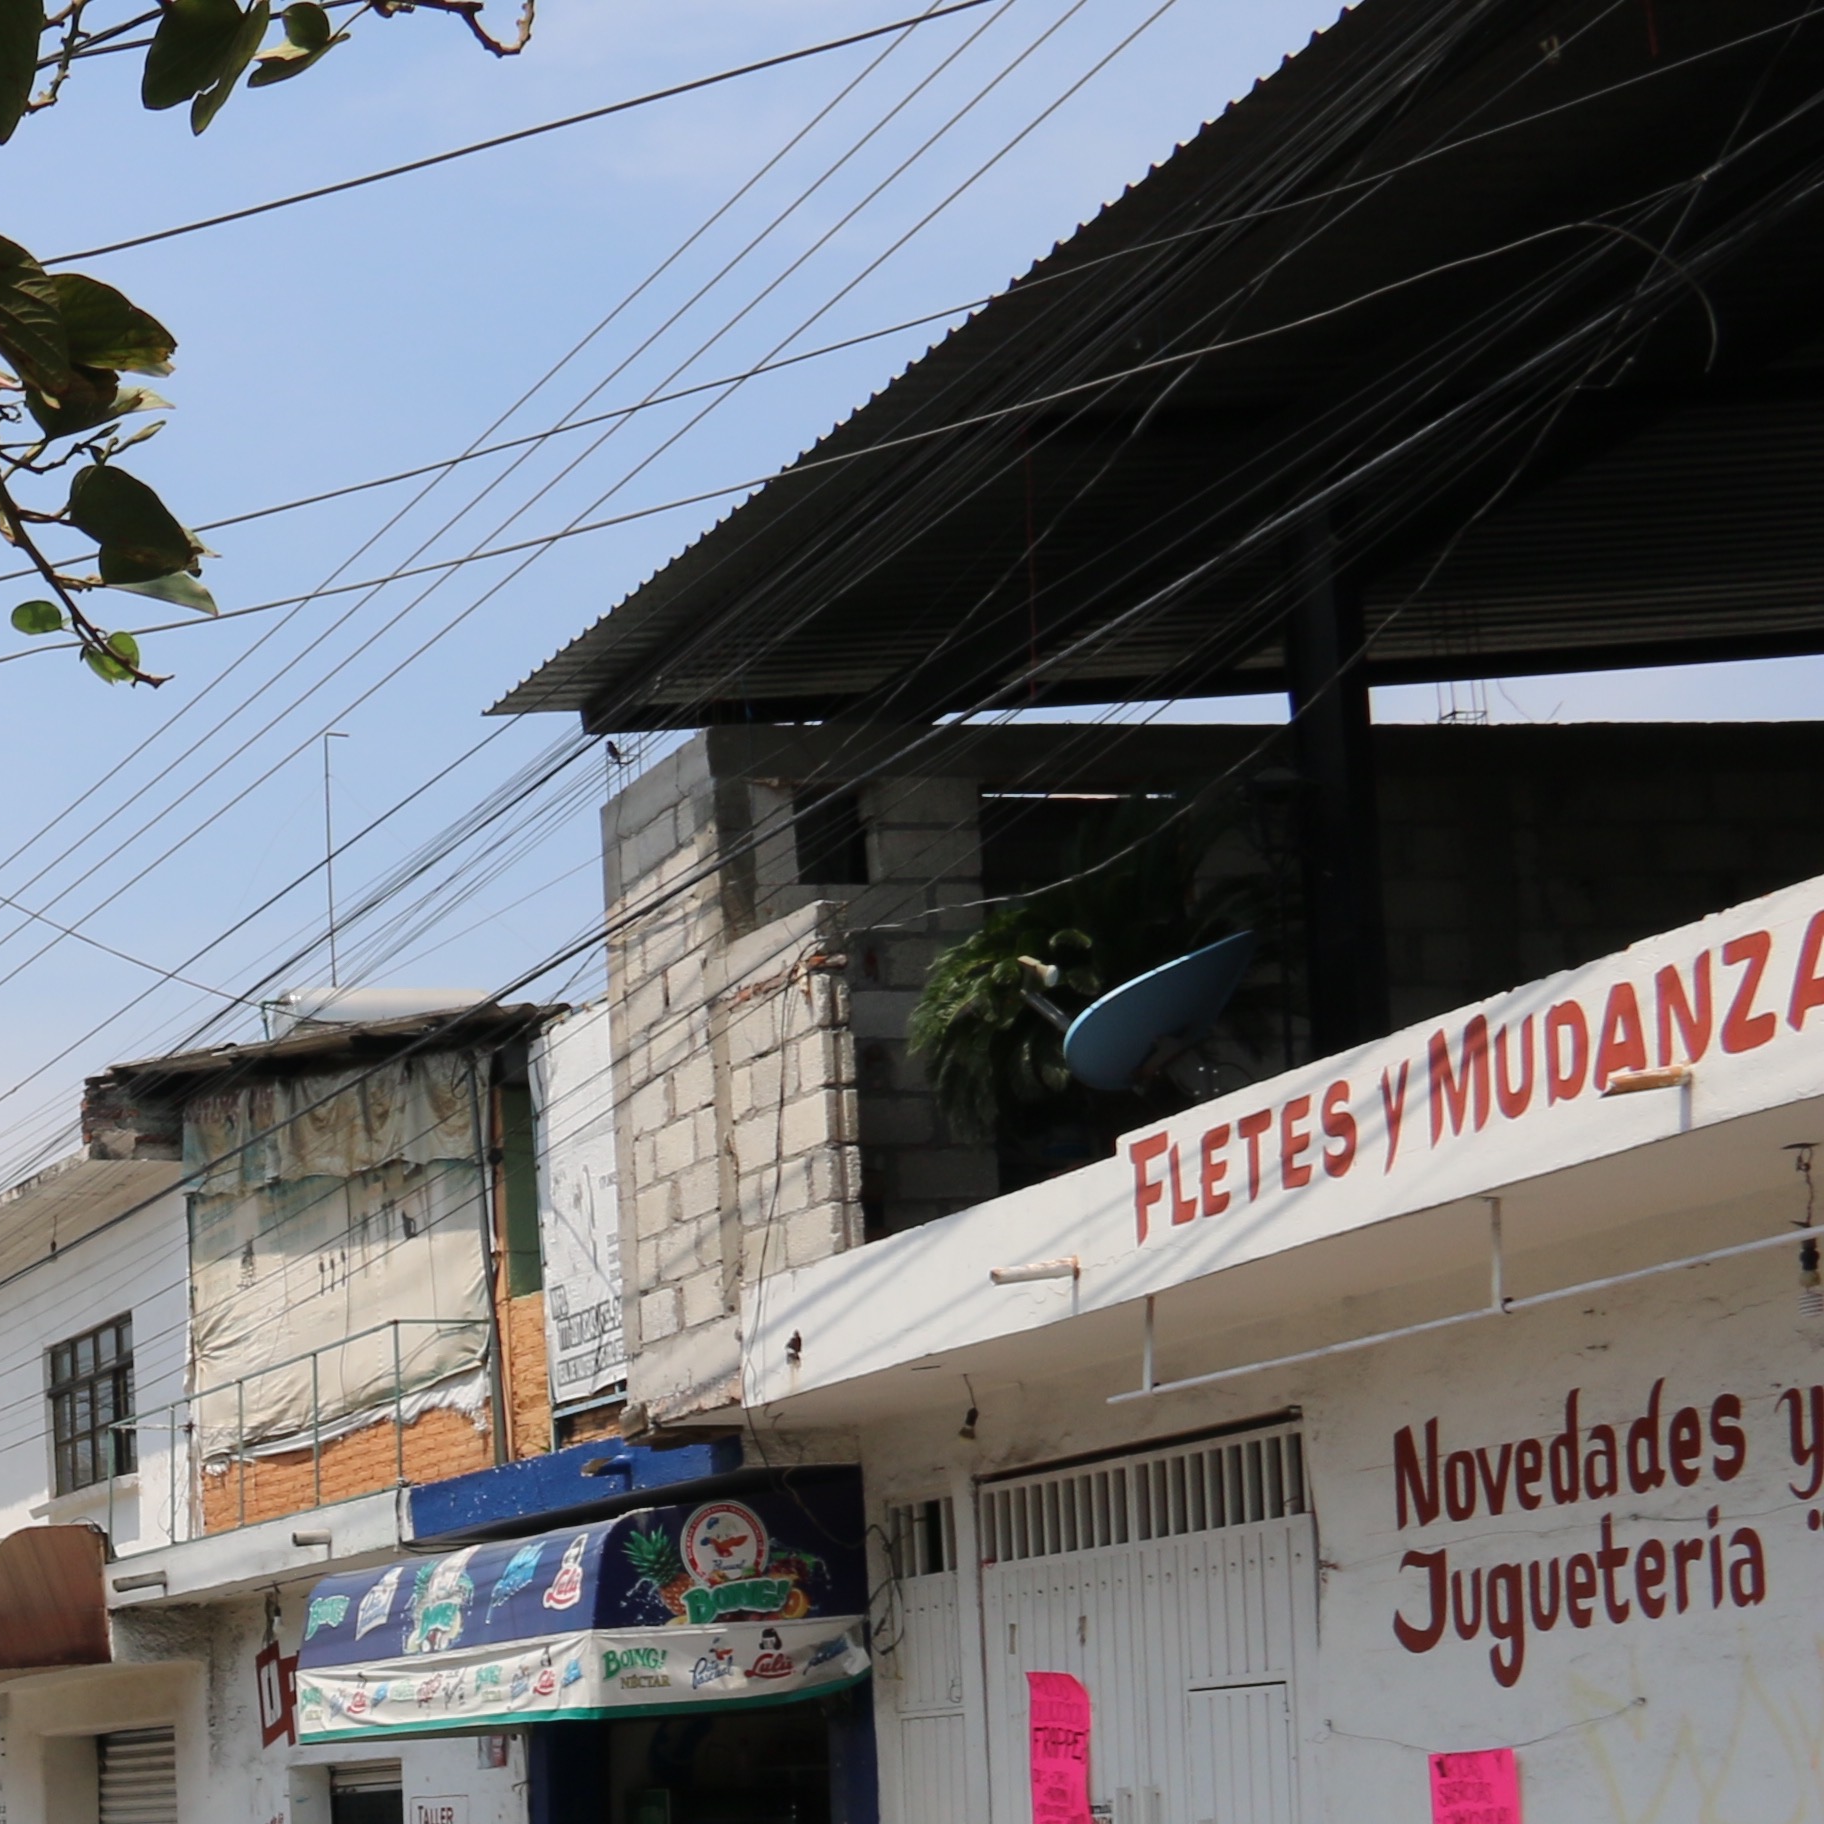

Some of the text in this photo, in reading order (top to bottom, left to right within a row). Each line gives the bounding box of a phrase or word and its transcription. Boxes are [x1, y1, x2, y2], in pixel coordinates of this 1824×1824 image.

[1128, 1079, 1357, 1247] FLETES
[1392, 1377, 1824, 1530] Novedades y
